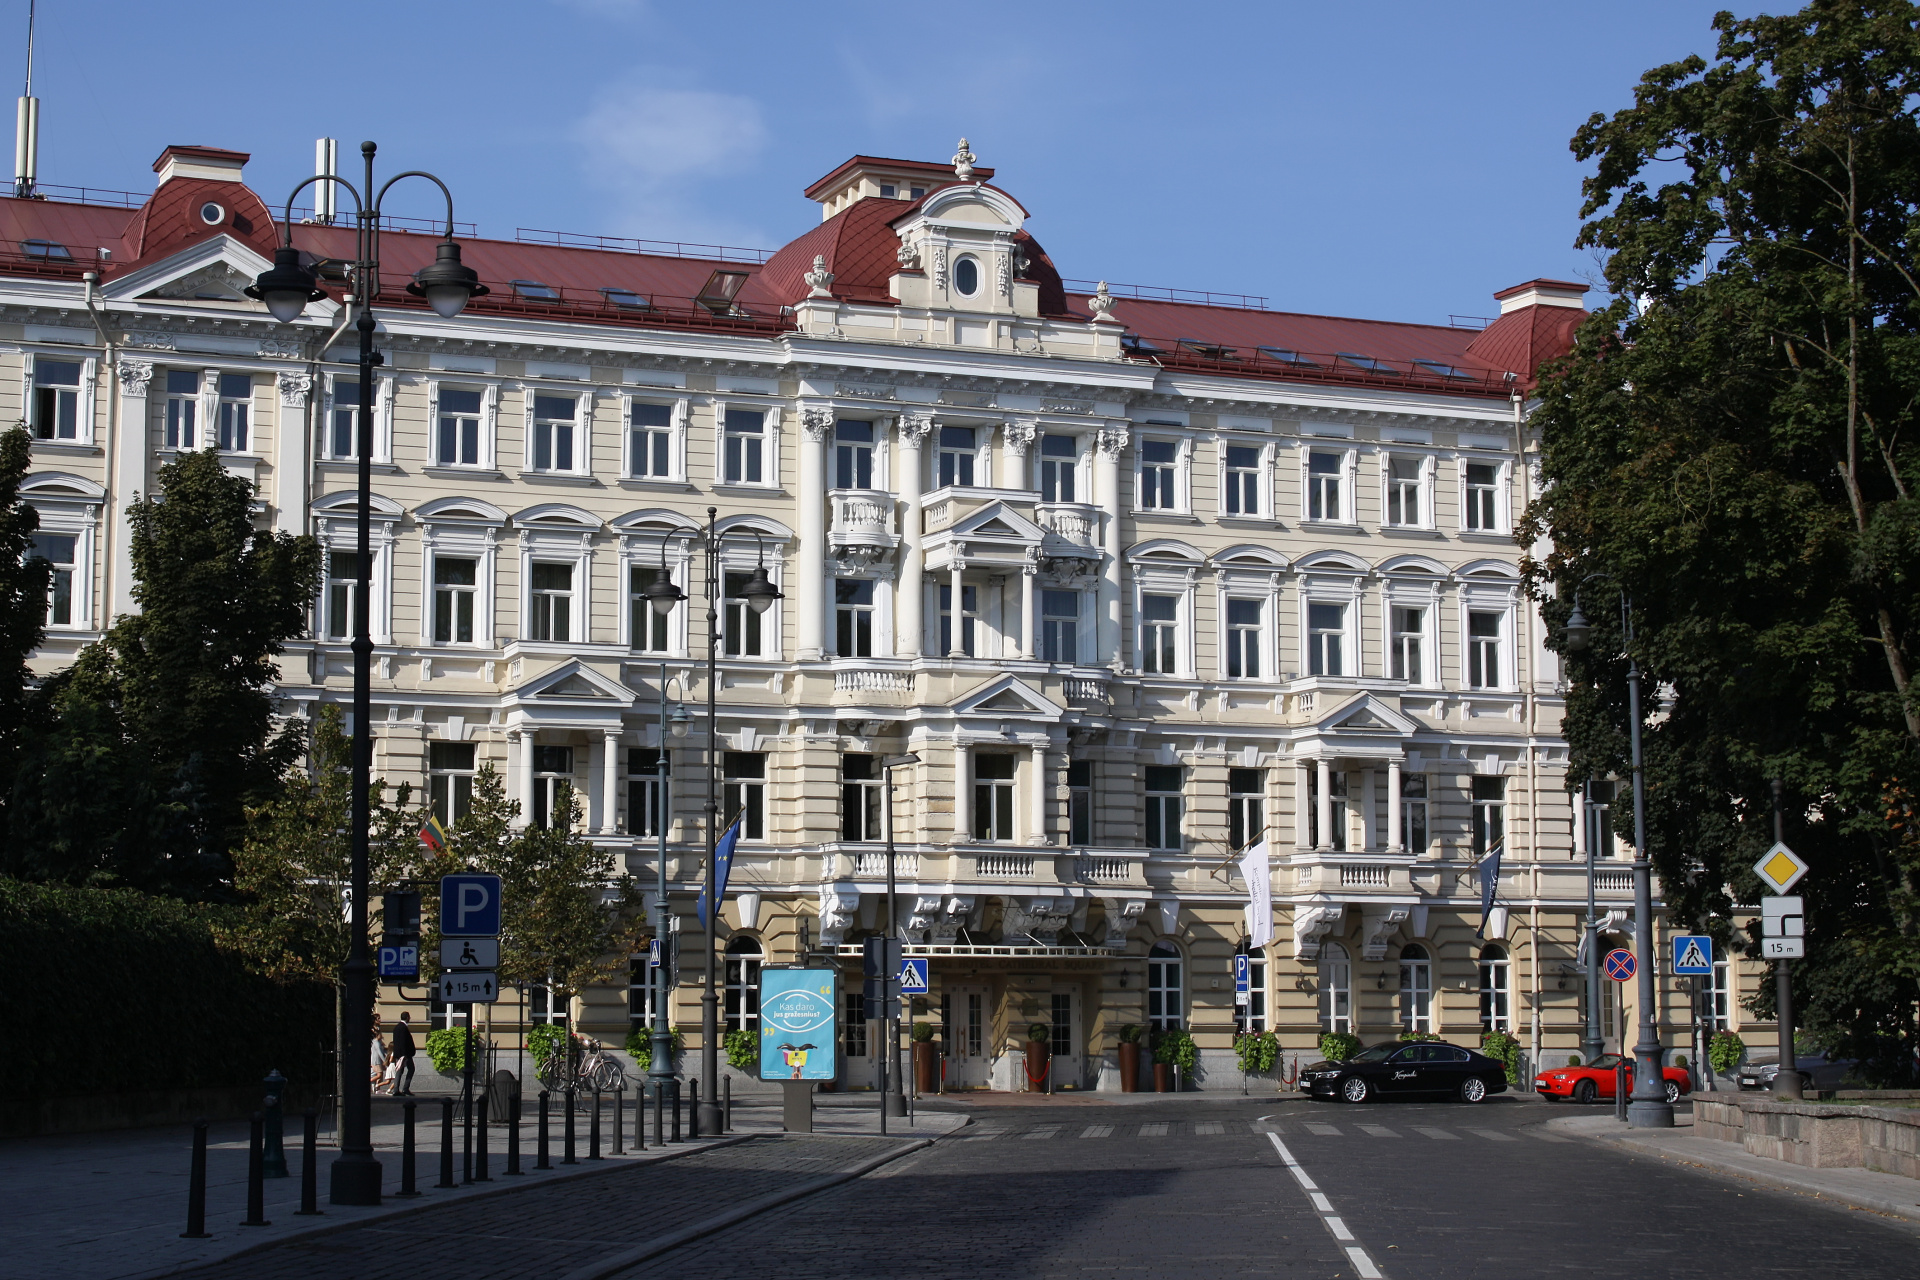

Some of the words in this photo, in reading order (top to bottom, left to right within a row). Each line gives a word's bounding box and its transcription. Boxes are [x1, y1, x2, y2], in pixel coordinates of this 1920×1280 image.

[457, 883, 489, 928] P
[1771, 943, 1783, 953] 15
[381, 947, 397, 975] P
[958, 959, 992, 969] HOTEL
[998, 959, 1059, 970] CATHEDRAL
[1238, 957, 1246, 978] P
[457, 983, 469, 992] 15
[471, 984, 480, 992] m
[779, 1002, 794, 1011] Kas
[795, 1002, 815, 1011] daro
[784, 1011, 820, 1019] gražesnius?
